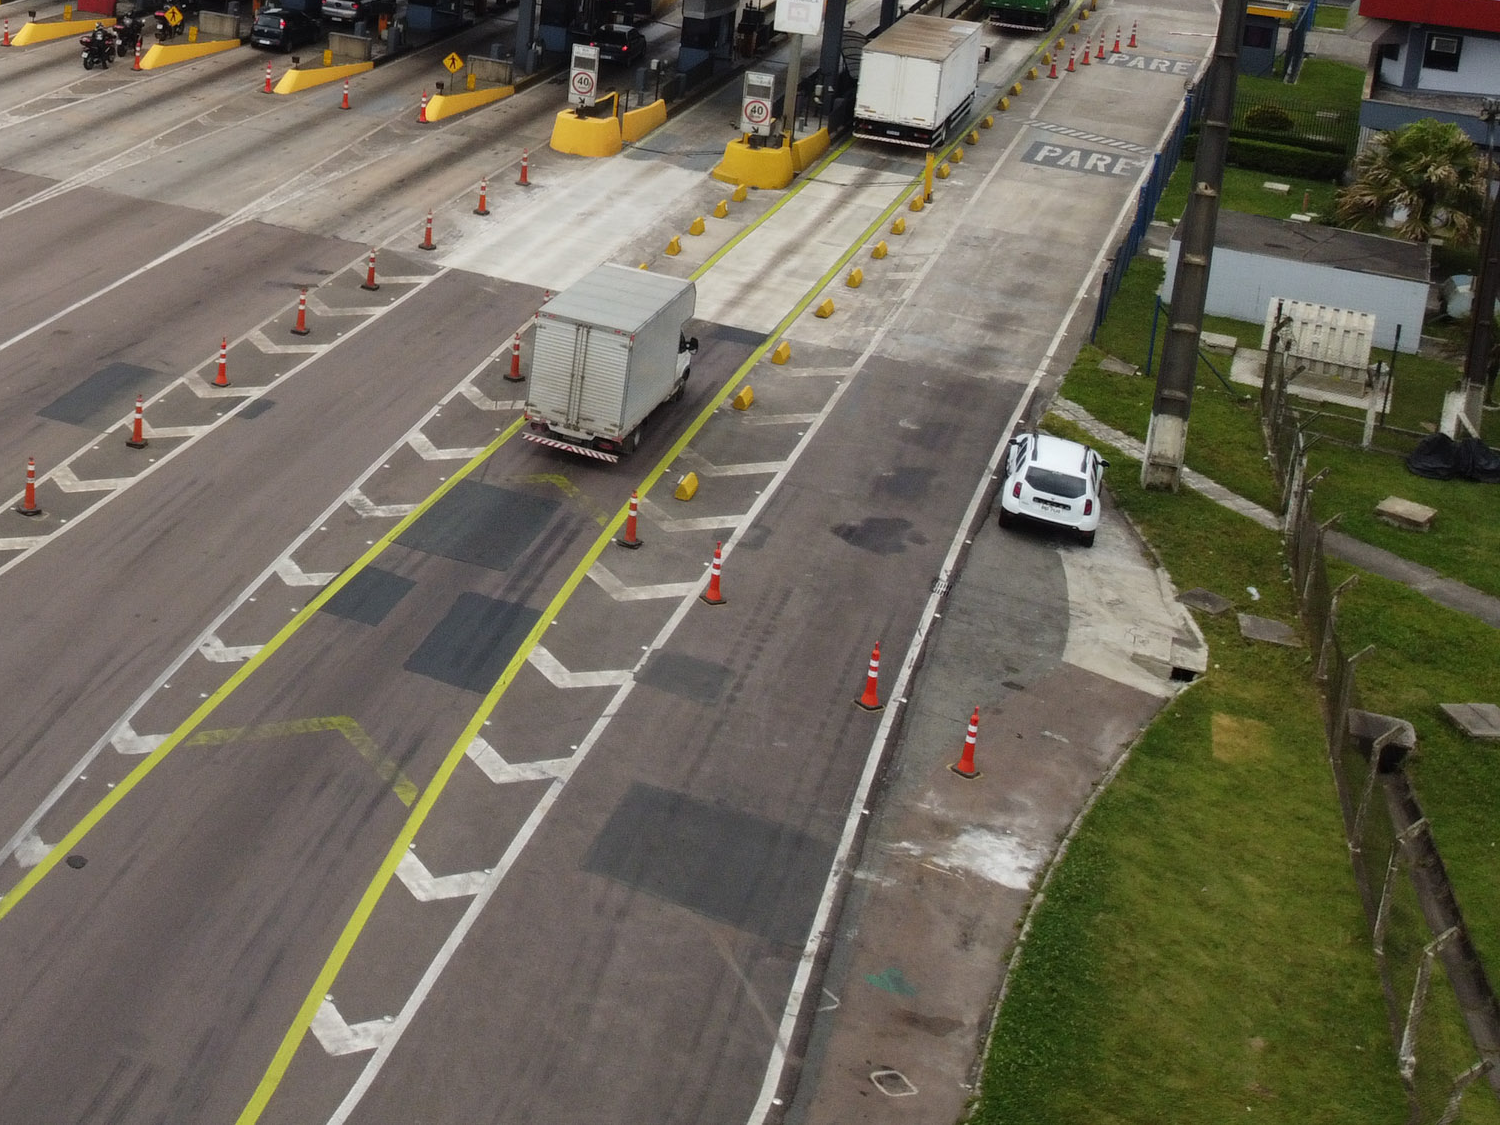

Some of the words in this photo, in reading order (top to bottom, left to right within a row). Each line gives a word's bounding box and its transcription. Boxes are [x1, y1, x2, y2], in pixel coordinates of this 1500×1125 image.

[1107, 53, 1193, 75] PARE
[577, 76, 590, 87] 40
[750, 105, 764, 116] 40
[1034, 145, 1141, 175] PARE
